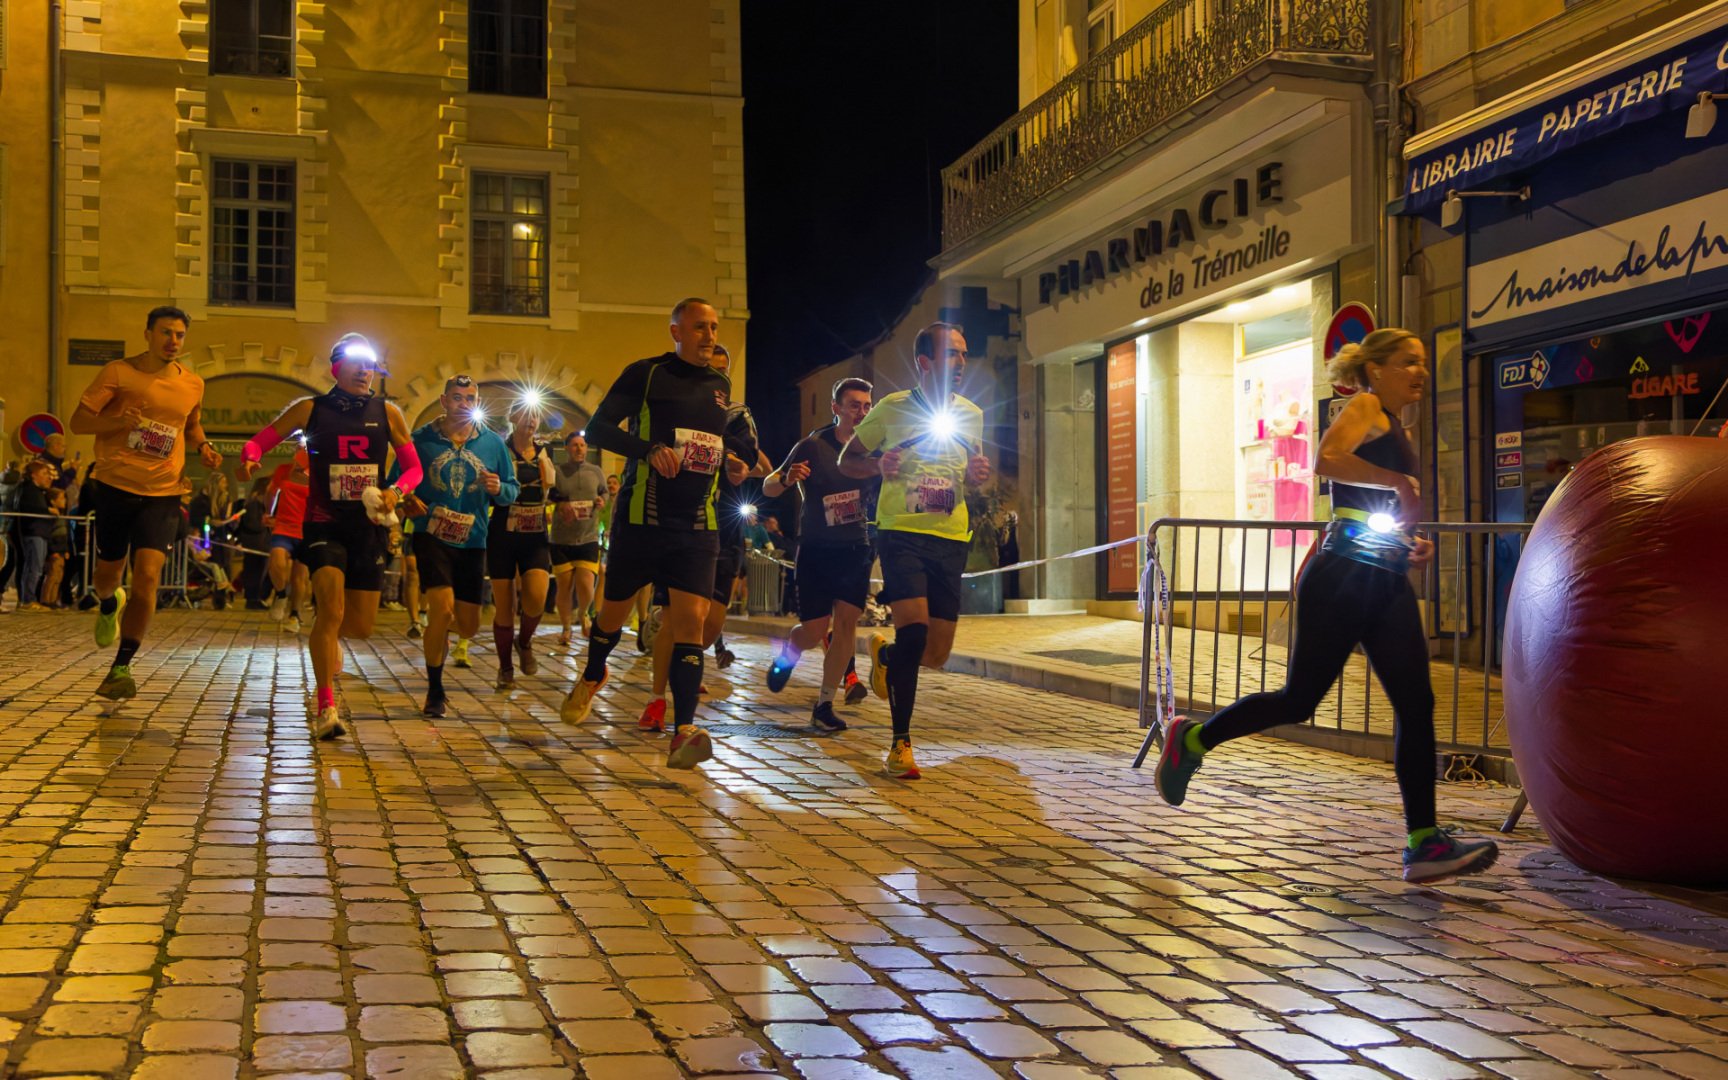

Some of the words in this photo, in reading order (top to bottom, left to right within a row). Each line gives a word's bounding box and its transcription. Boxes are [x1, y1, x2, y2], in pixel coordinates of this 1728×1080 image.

[1410, 127, 1519, 193] LIBRAIRIE
[1537, 57, 1688, 143] PAPETERIE
[1039, 162, 1283, 304] PHARMACIE
[1140, 277, 1163, 309] de
[1167, 269, 1184, 300] la
[1191, 225, 1291, 289] Trémoille
[1503, 364, 1526, 383] FDJ
[337, 435, 369, 460] R
[684, 440, 714, 463] 1252
